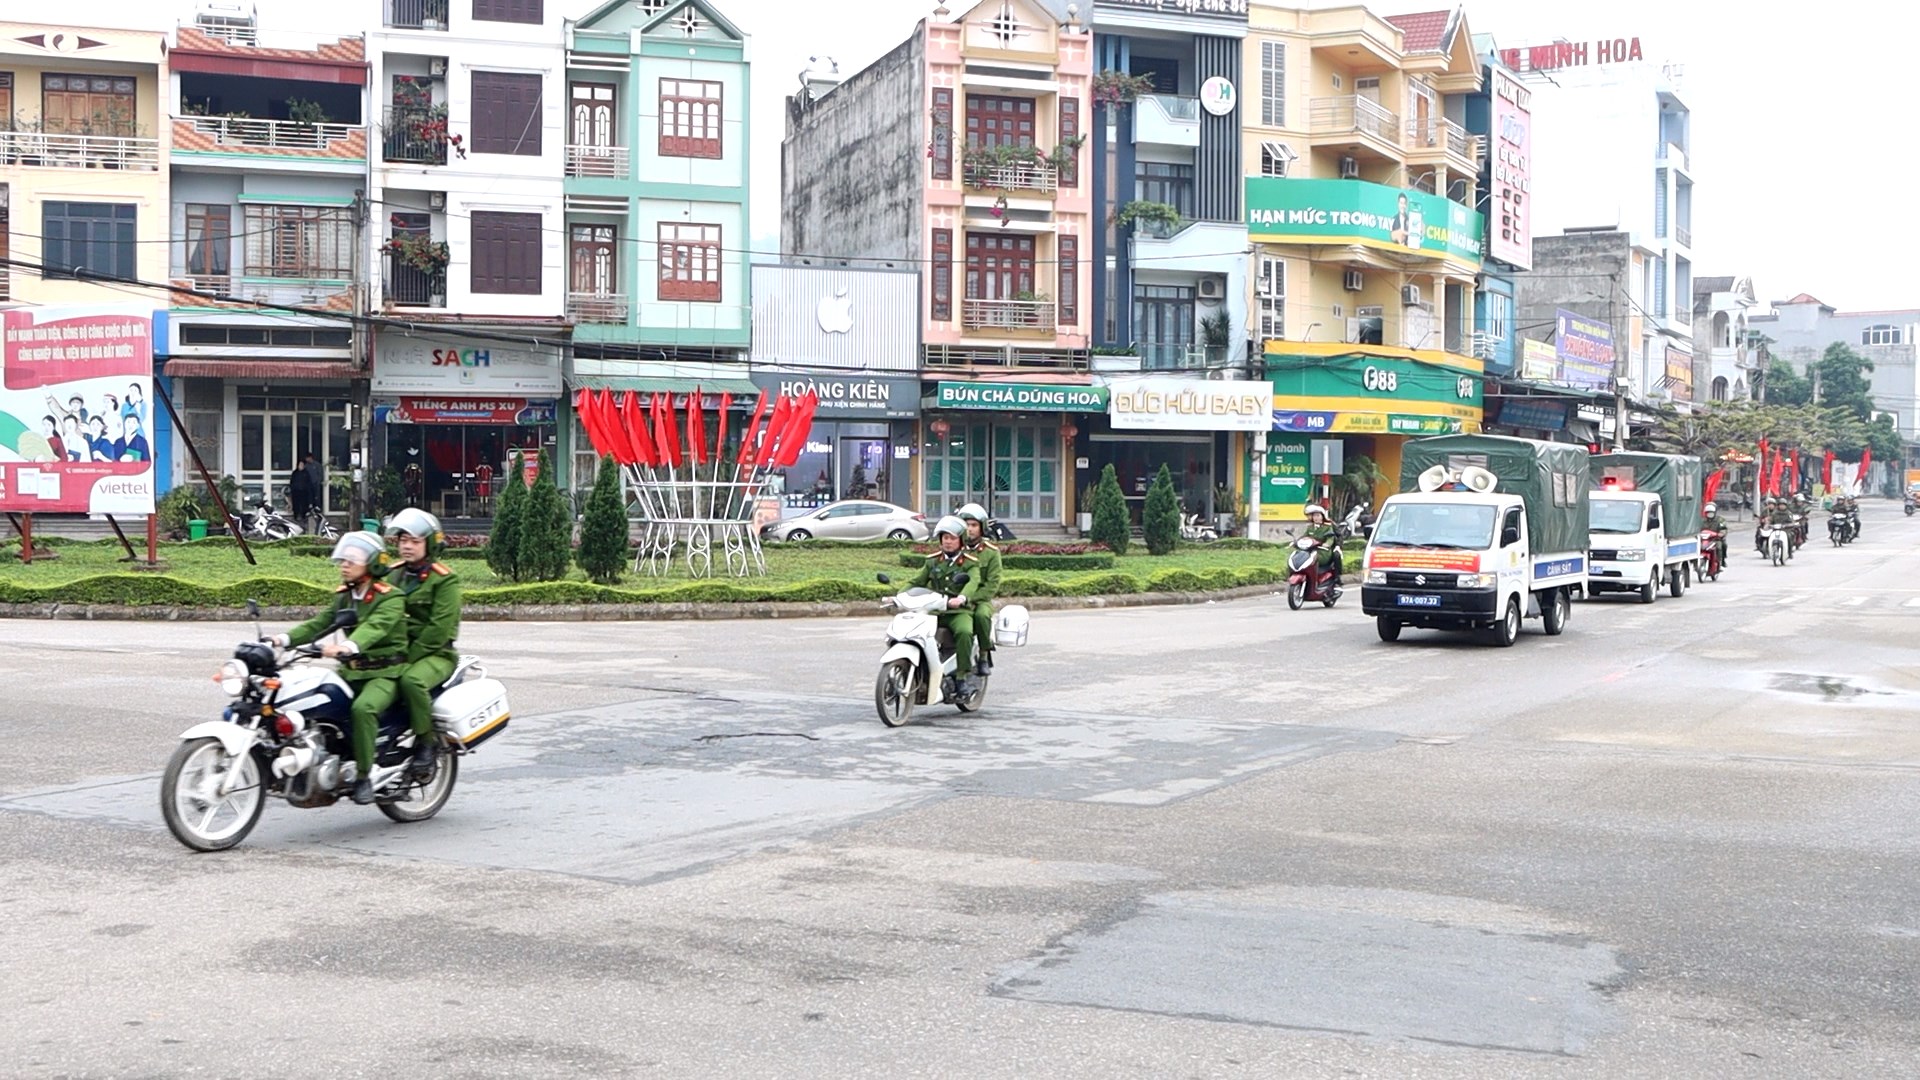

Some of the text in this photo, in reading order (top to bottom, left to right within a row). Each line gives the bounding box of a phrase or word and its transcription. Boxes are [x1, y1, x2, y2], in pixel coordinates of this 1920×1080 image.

[1529, 42, 1588, 72] MINH
[1597, 37, 1643, 65] HOA
[1250, 209, 1285, 228] HẠN
[1288, 206, 1327, 225] MỨC
[1329, 210, 1377, 227] TRONG
[1377, 217, 1395, 232] TAY
[781, 378, 889, 400] HOÀNG KIÊN
[1364, 366, 1398, 392] F88
[411, 399, 516, 411] TIẾNG ANH MS XU
[943, 386, 979, 402] BÚN
[982, 388, 1015, 403] CHẢ
[1067, 392, 1102, 405] HOA
[1116, 386, 1268, 416] ĐỨC HỮU BABY
[1307, 416, 1325, 428] MB
[1274, 443, 1305, 453] nhanh
[1280, 463, 1292, 475] ký
[1293, 466, 1305, 474] xe
[100, 482, 149, 494] viettel
[469, 700, 500, 729] CSTT
